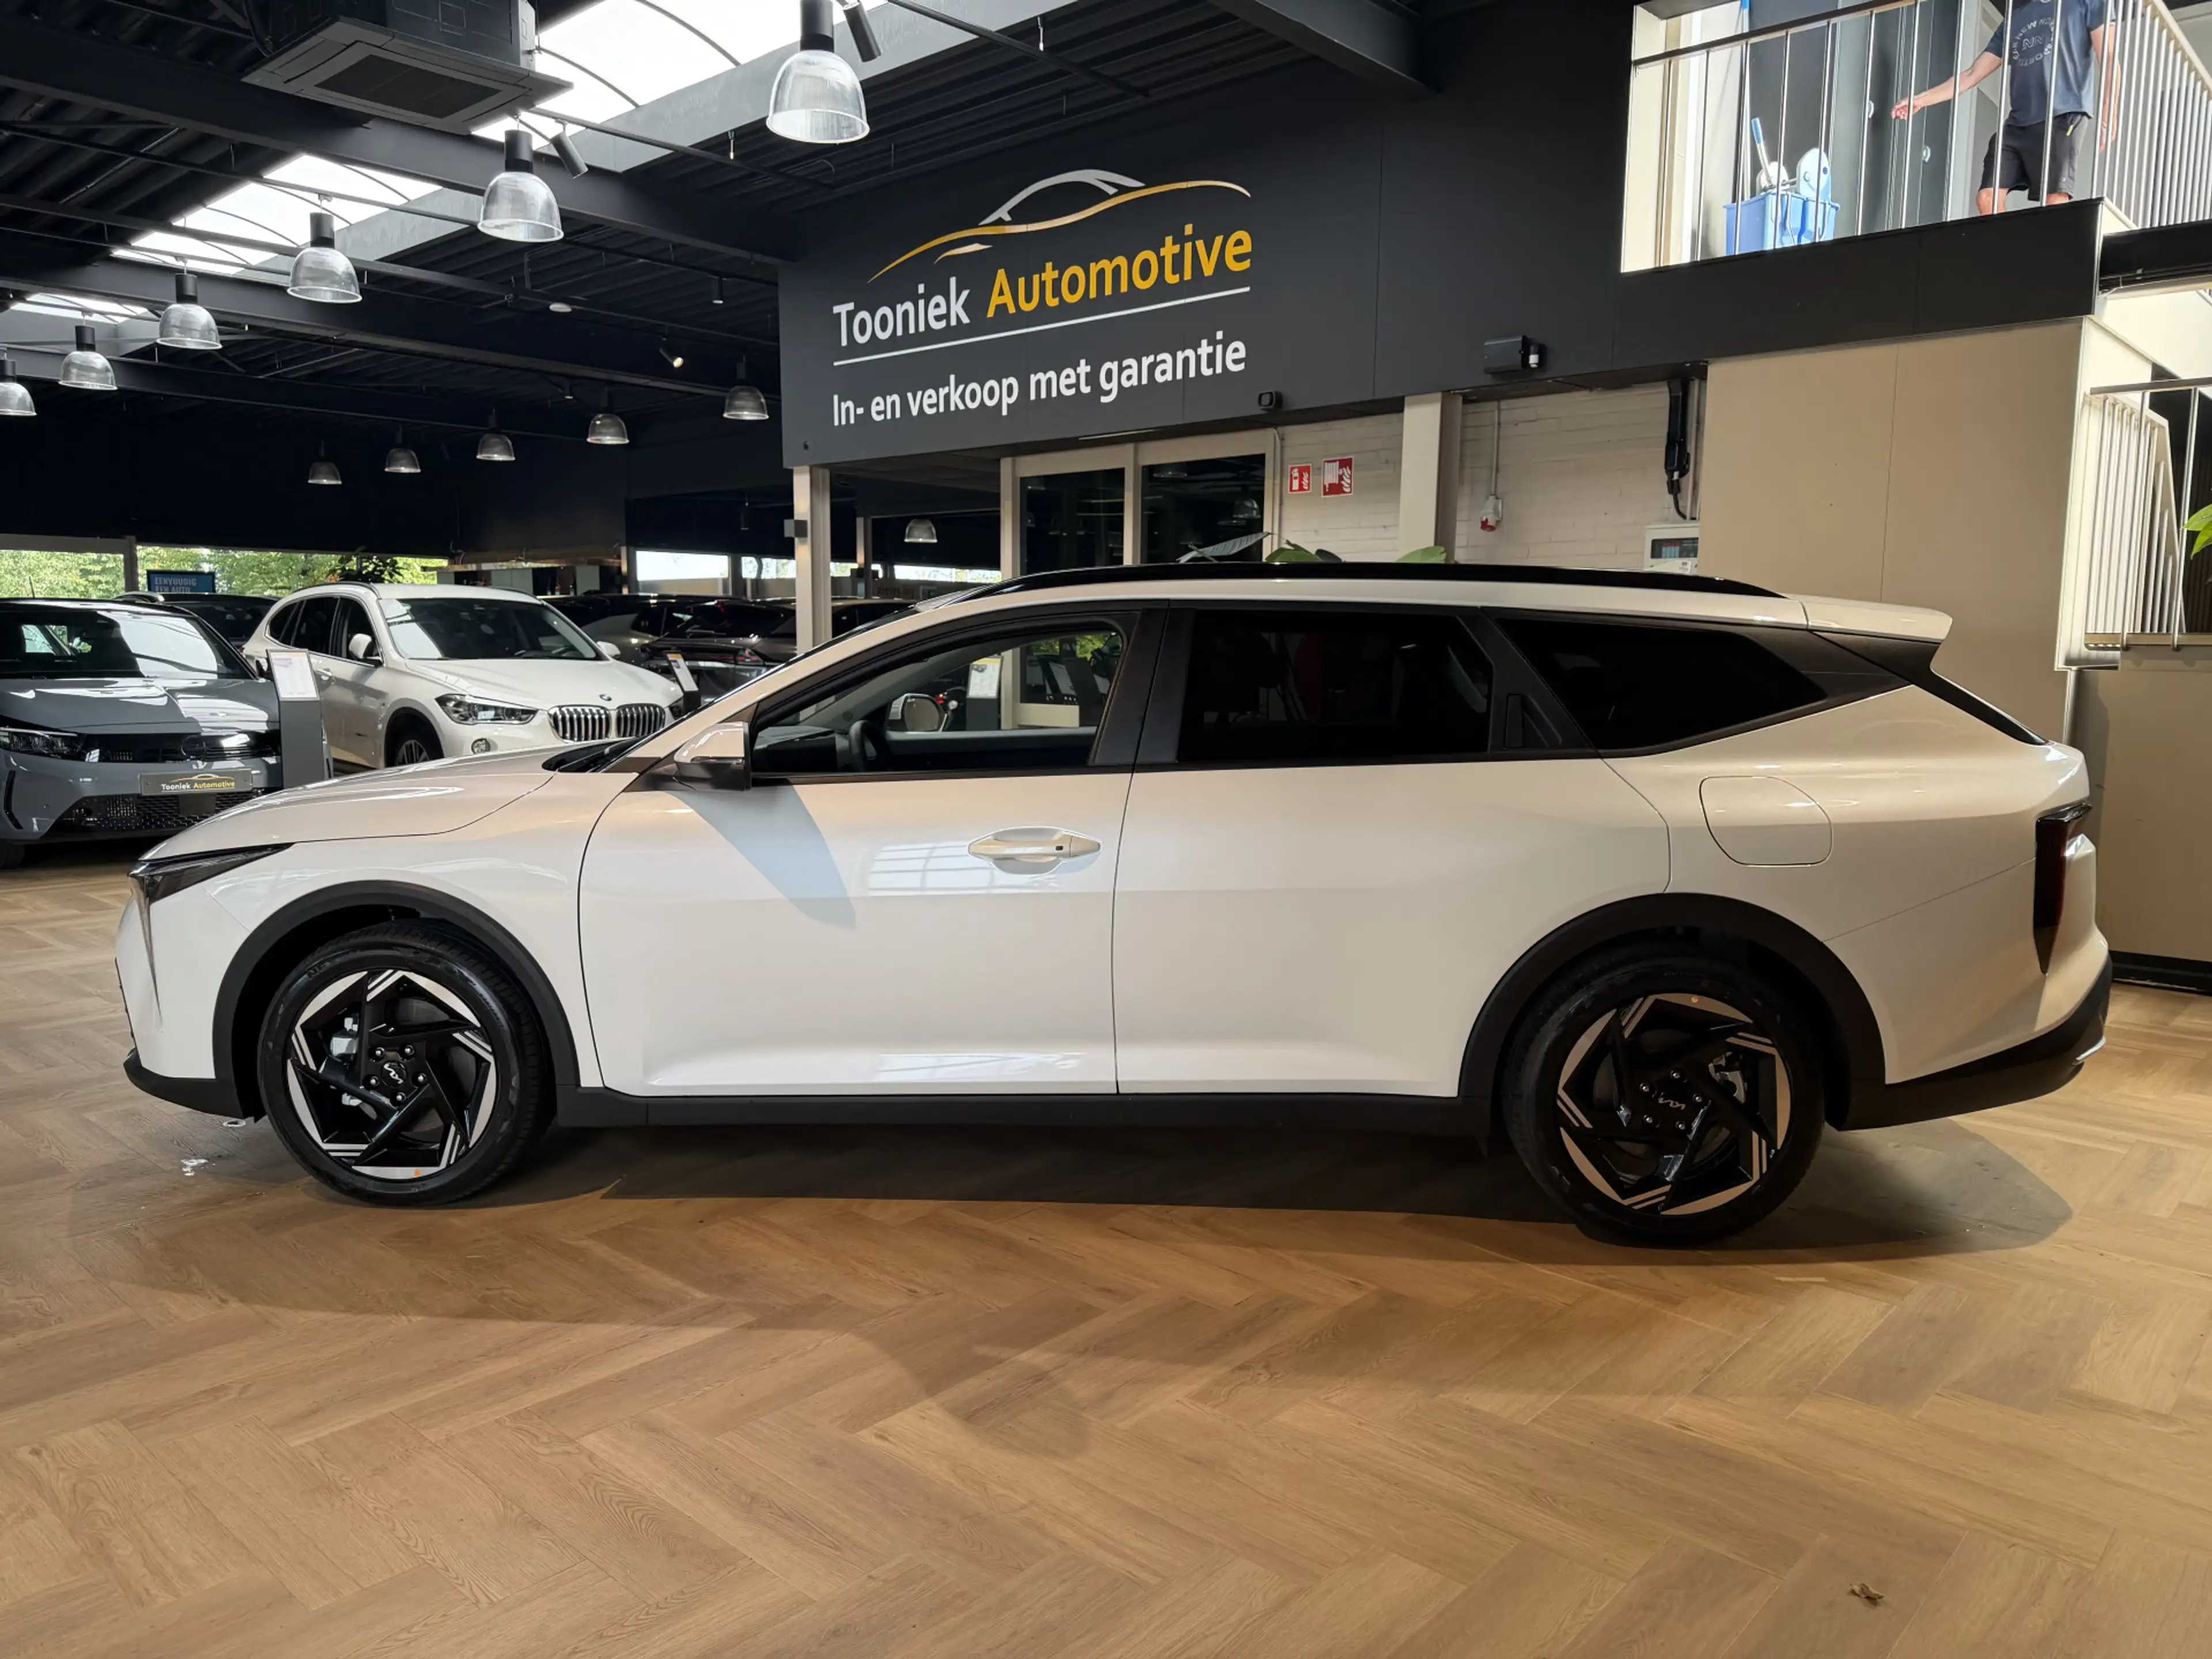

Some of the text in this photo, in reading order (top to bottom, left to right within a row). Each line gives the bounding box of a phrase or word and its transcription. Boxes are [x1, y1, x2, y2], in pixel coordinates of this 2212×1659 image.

[832, 223, 1252, 347] Tooniek Automotive
[833, 330, 1247, 427] In- en verkoop met garantie
[161, 781, 236, 790] Tooniek Automotive
